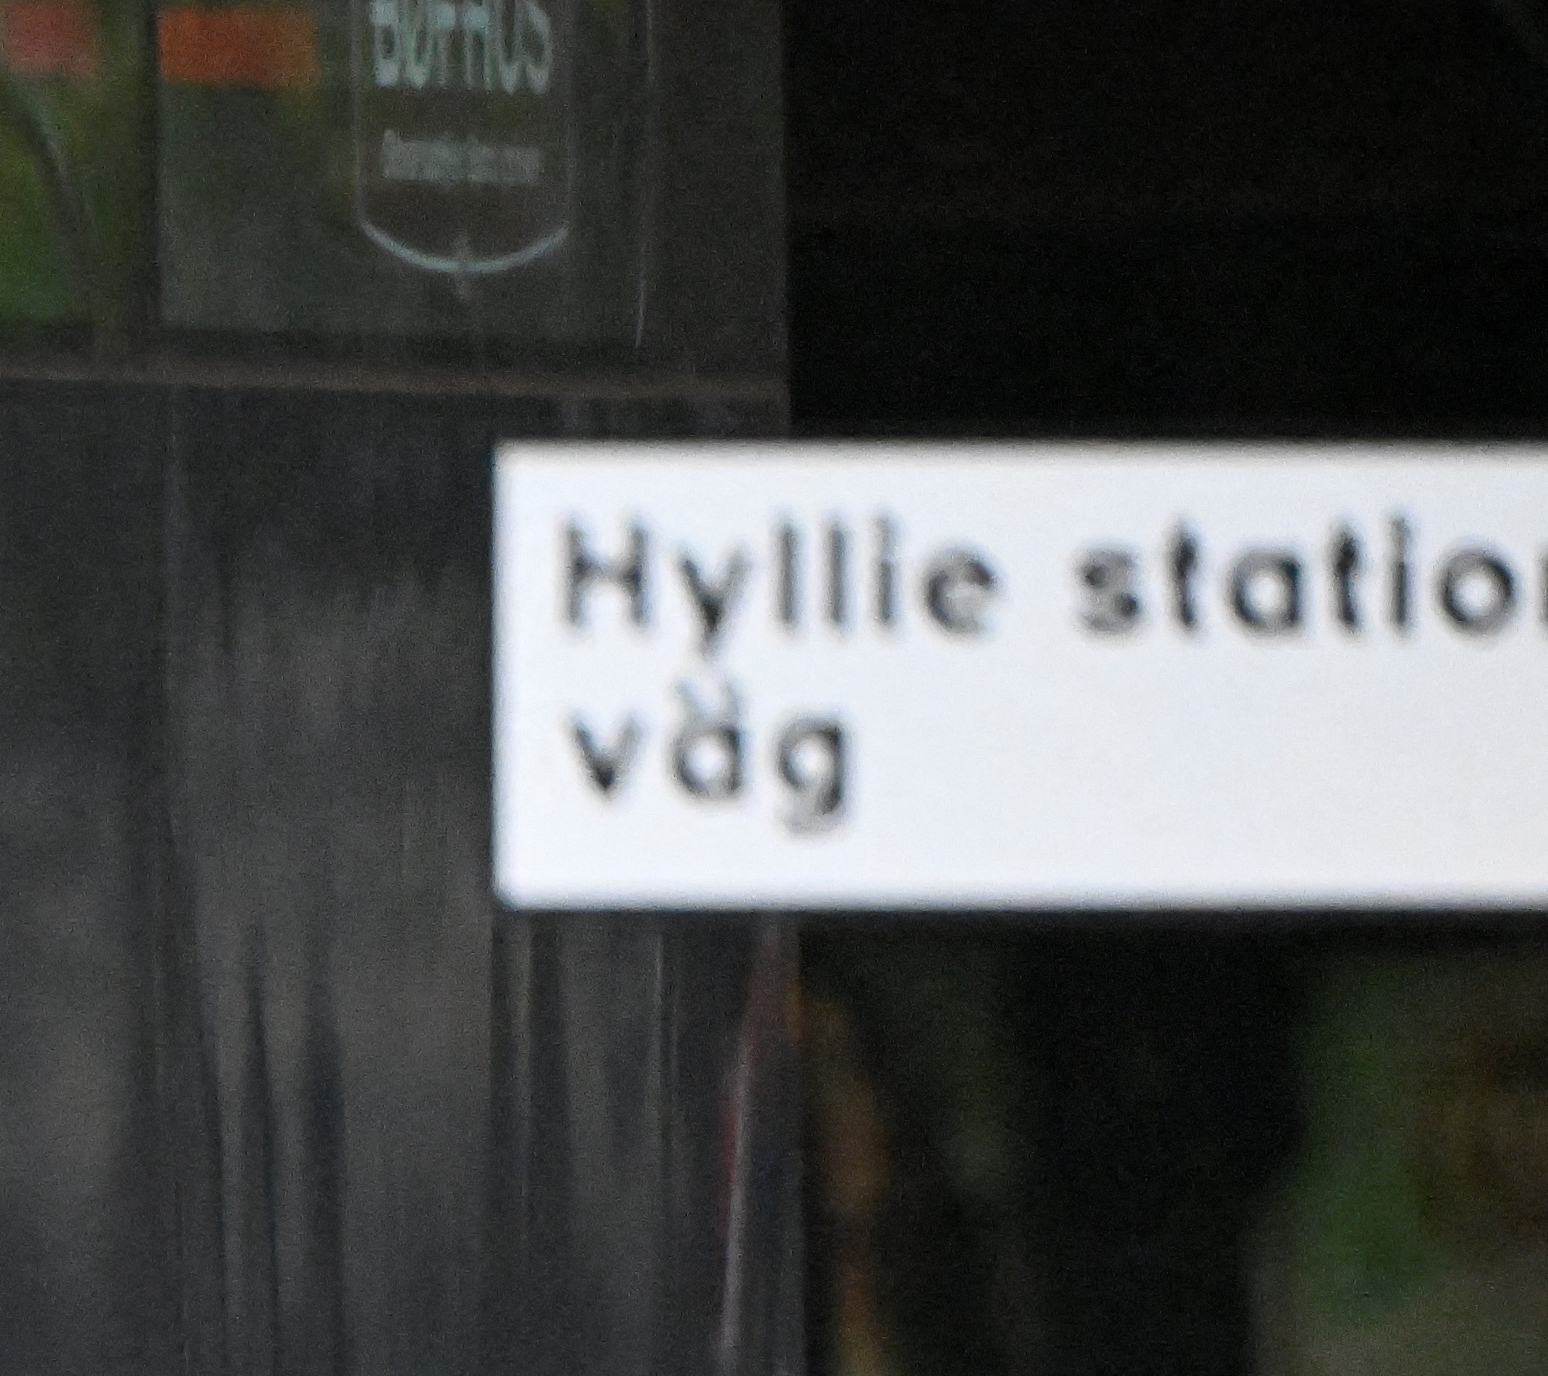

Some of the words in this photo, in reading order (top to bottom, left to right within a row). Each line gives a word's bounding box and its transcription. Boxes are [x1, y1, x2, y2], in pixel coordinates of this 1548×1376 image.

[560, 510, 1001, 656] Hyllie
[1072, 508, 1548, 638] statio
[566, 674, 850, 836] väg
